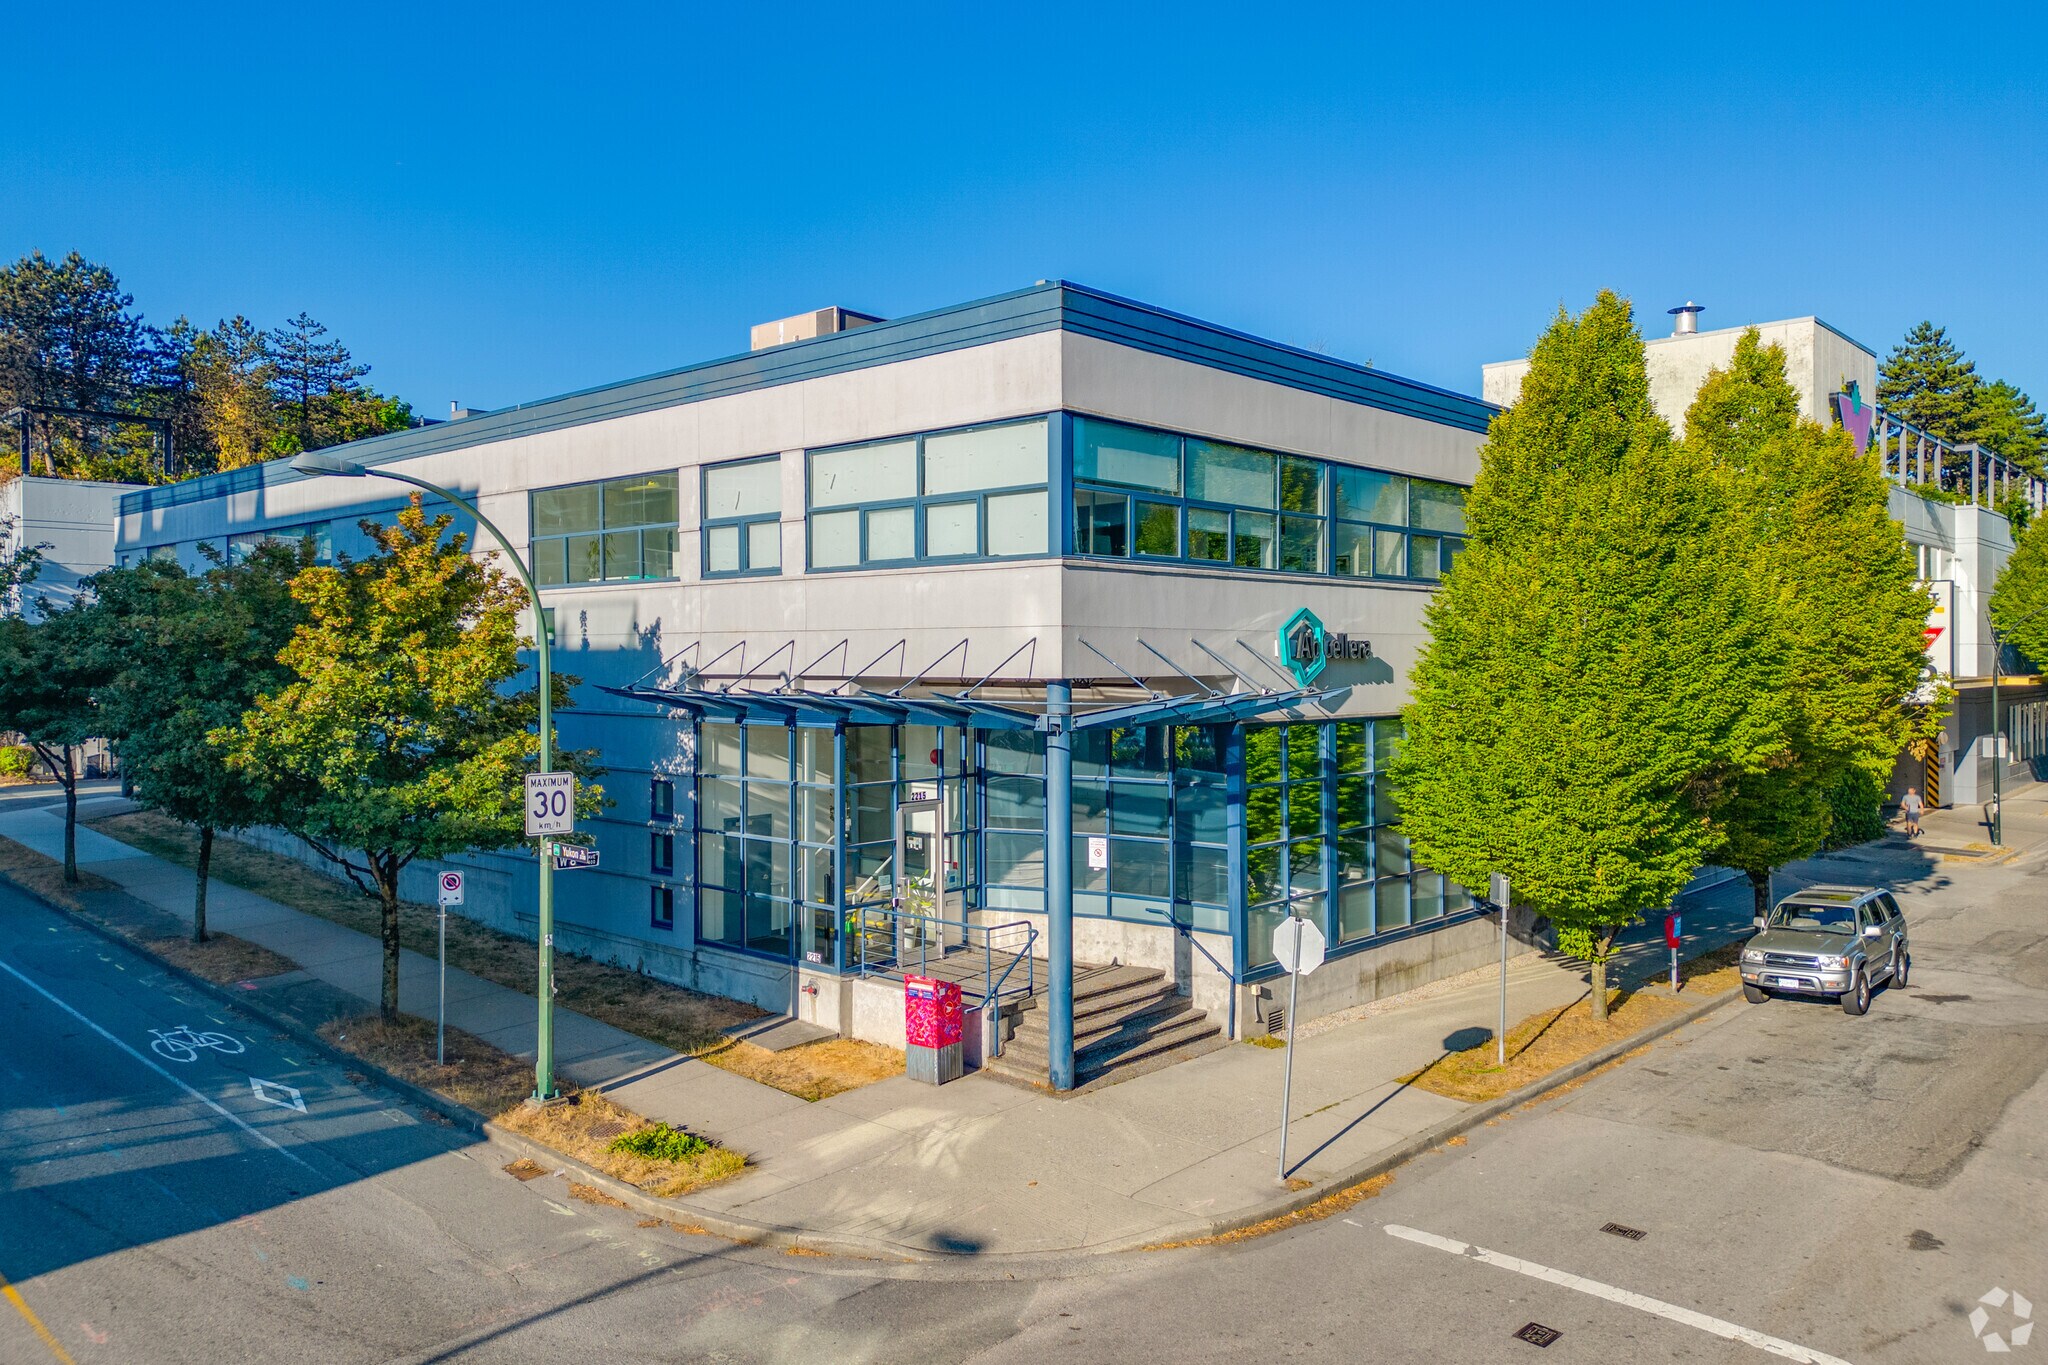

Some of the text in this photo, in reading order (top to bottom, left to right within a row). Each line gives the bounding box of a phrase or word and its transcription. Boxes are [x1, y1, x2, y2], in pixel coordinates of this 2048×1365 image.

[530, 777, 569, 788] MAXIMUM
[911, 791, 926, 801] 2215
[533, 790, 566, 818] 30
[538, 820, 561, 830] km/h
[562, 846, 579, 859] Yukon
[560, 857, 568, 867] W
